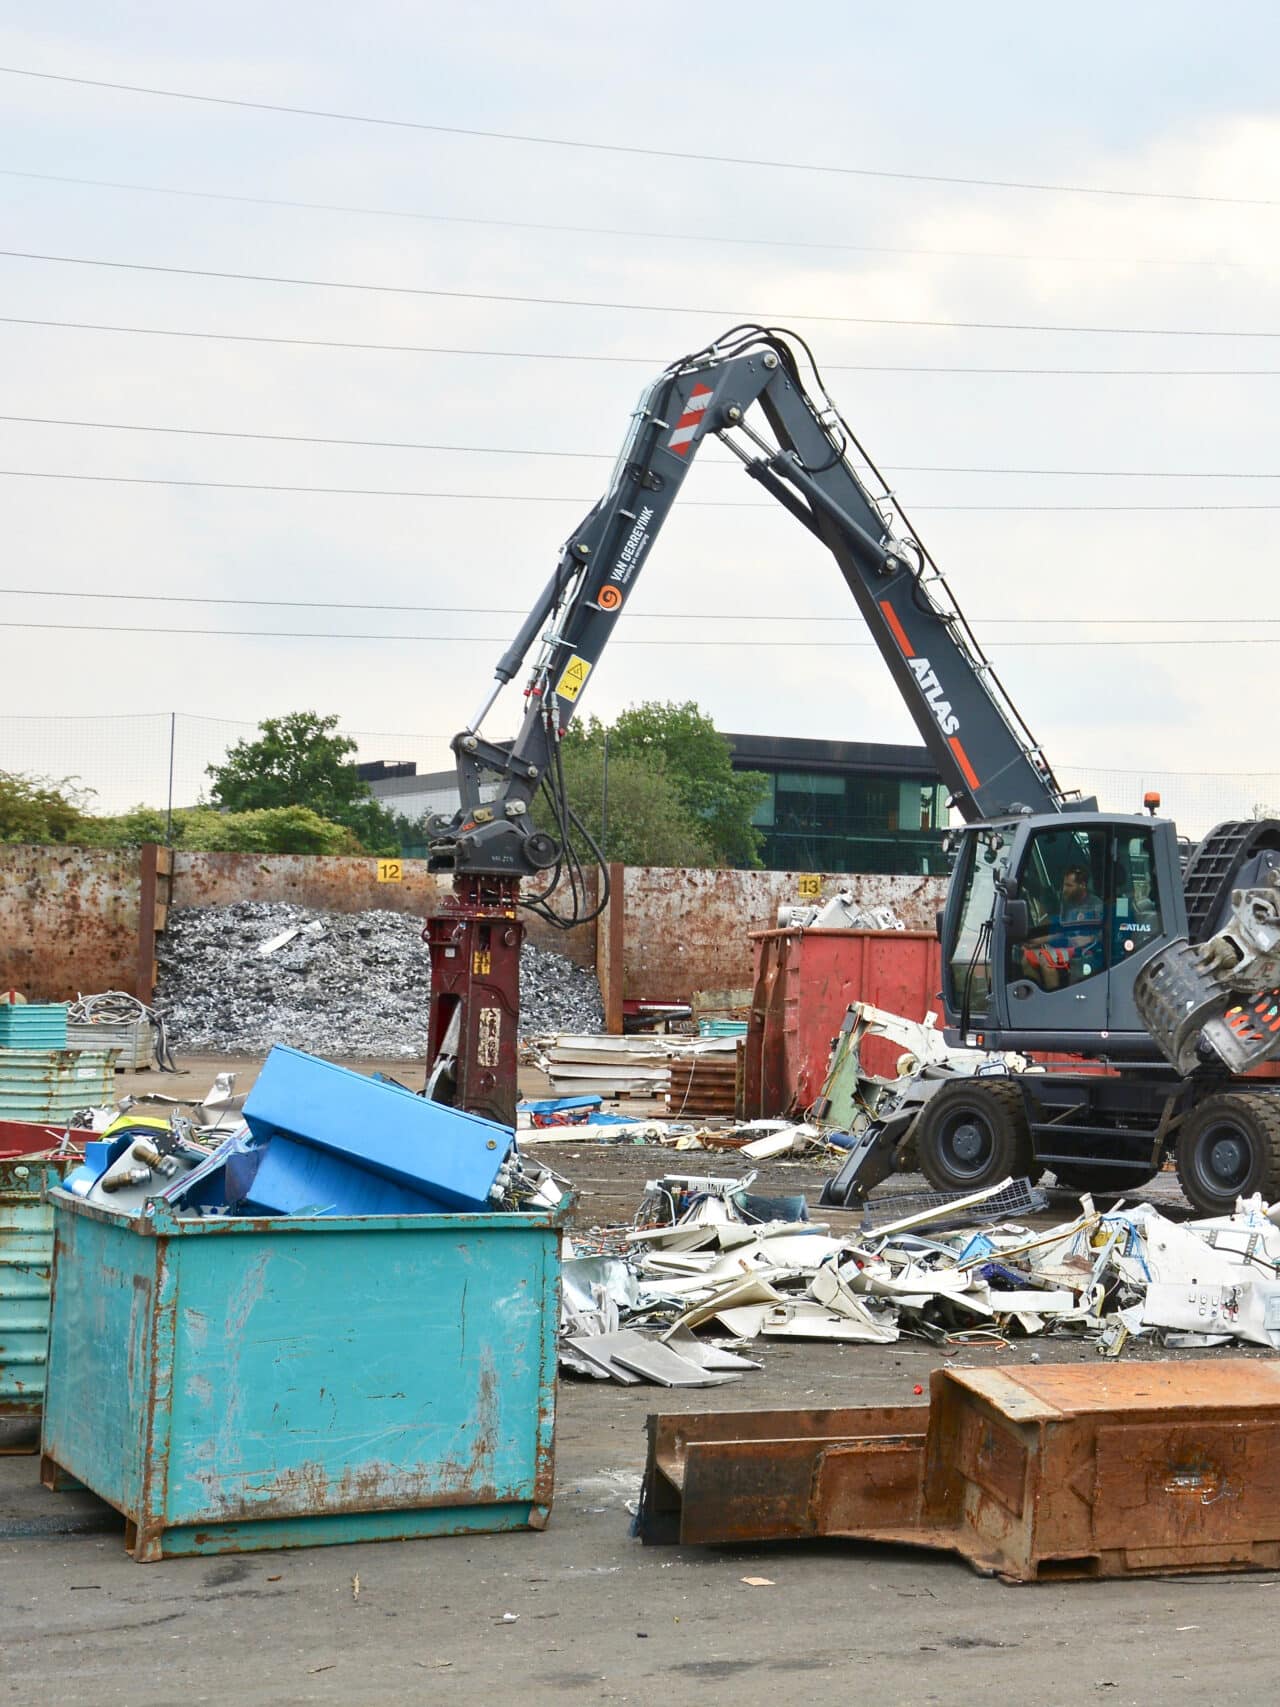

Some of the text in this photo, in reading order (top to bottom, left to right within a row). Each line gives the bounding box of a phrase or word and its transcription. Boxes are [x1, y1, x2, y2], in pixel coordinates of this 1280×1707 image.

[610, 560, 628, 581] VAN
[908, 658, 960, 735] ATLAS
[379, 864, 400, 879] 12
[799, 880, 819, 894] 13
[1127, 923, 1151, 932] ATLAS
